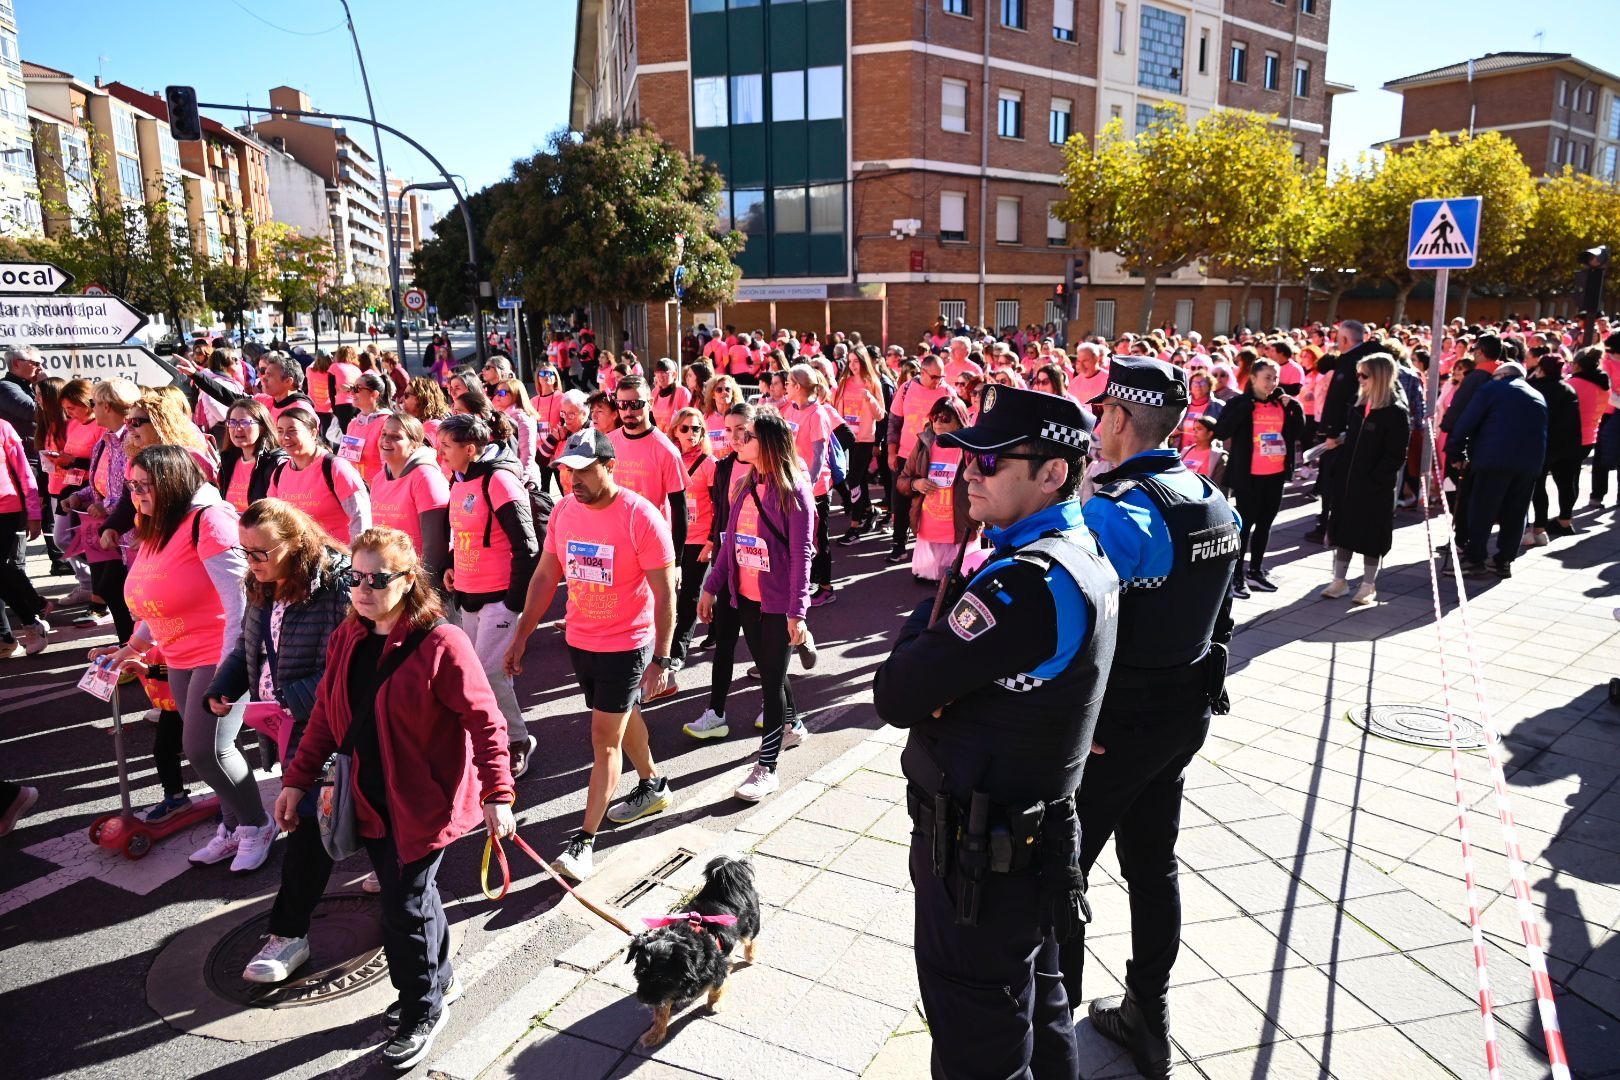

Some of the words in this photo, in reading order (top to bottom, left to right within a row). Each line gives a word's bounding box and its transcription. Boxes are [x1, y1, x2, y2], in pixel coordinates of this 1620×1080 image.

[0, 267, 54, 286] ocal
[408, 296, 421, 304] 30
[36, 302, 107, 320] municipal
[39, 353, 137, 370] ROVINCIAL
[746, 546, 762, 556] 1034
[1191, 533, 1239, 562] POLICIA
[582, 556, 603, 568] 1024
[579, 591, 618, 601] Carrera
